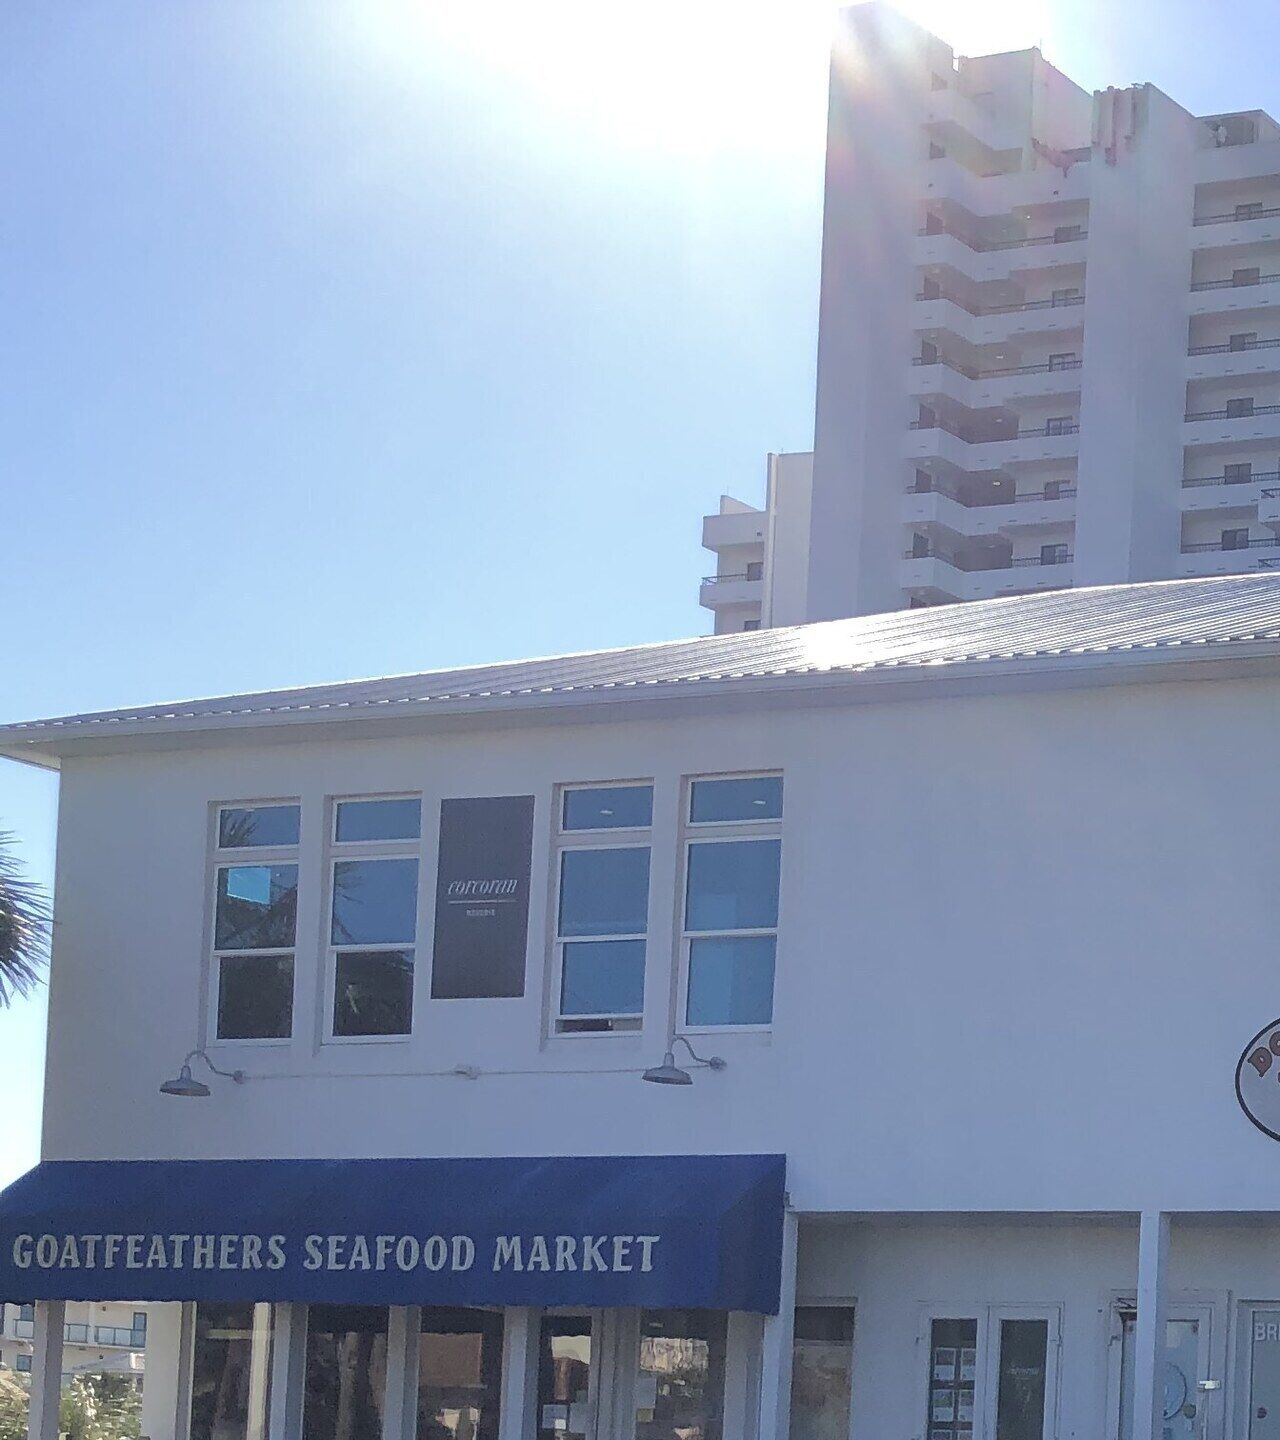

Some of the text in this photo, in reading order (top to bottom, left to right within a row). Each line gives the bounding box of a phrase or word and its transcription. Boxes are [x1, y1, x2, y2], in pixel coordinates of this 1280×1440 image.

[12, 1234, 661, 1272] GOATFEATHERS SEAFOOD MARKET
